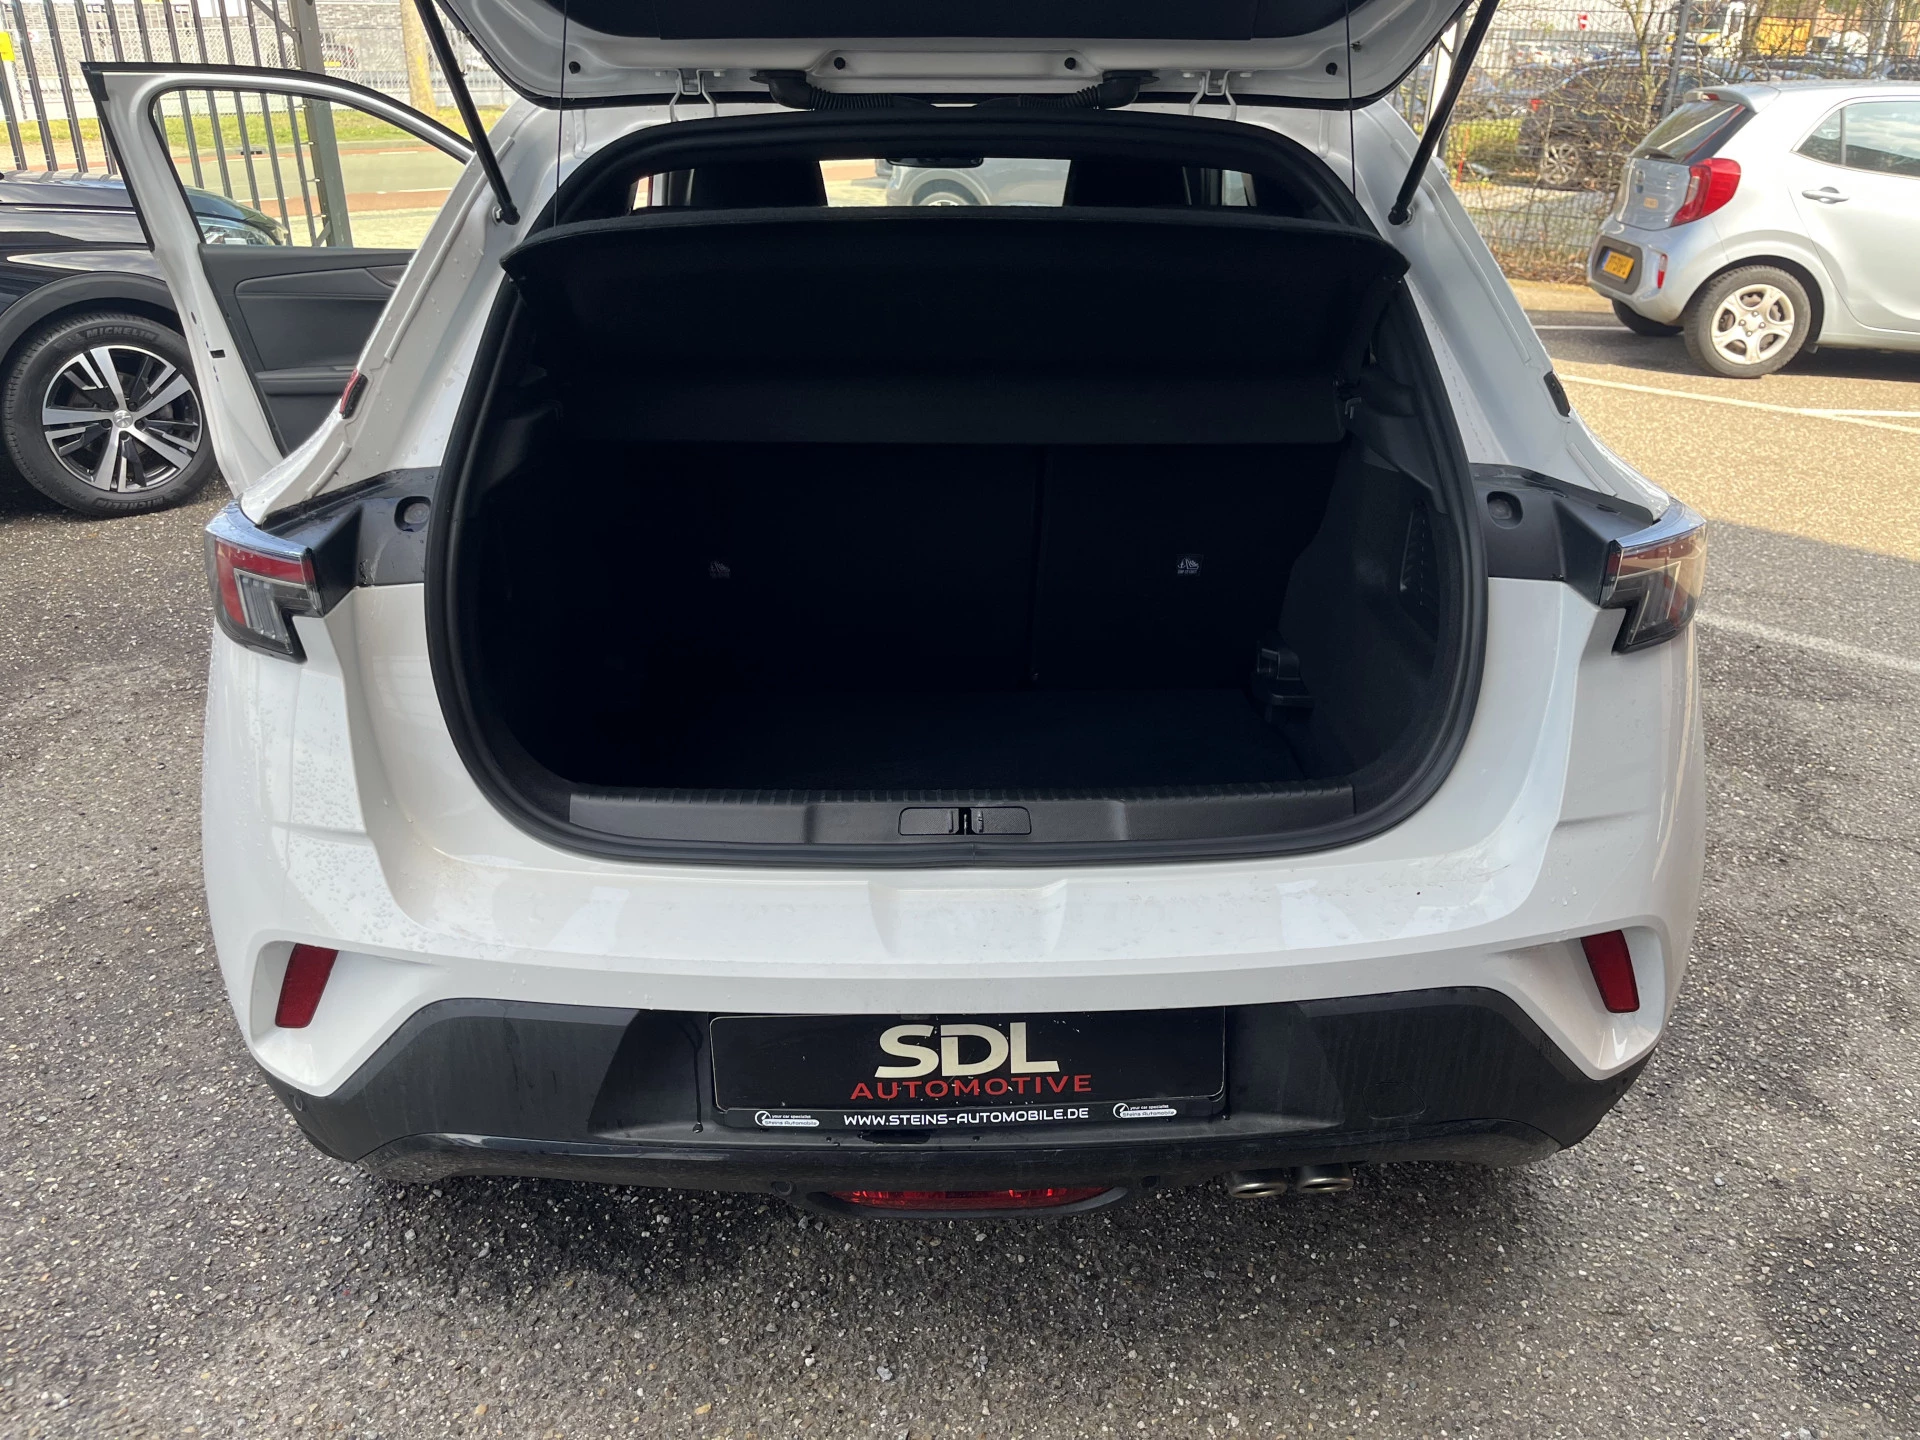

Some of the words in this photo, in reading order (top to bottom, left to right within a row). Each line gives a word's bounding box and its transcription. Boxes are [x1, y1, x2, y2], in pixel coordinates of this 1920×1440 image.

[86, 326, 156, 341] MICHELIN
[95, 496, 164, 510] MICHELIN
[874, 1022, 1060, 1078] SDL
[850, 1074, 1092, 1100] AUTOMOTIVE
[843, 1108, 1089, 1126] WWW.STEINS-AUTOMOBILE.DE
